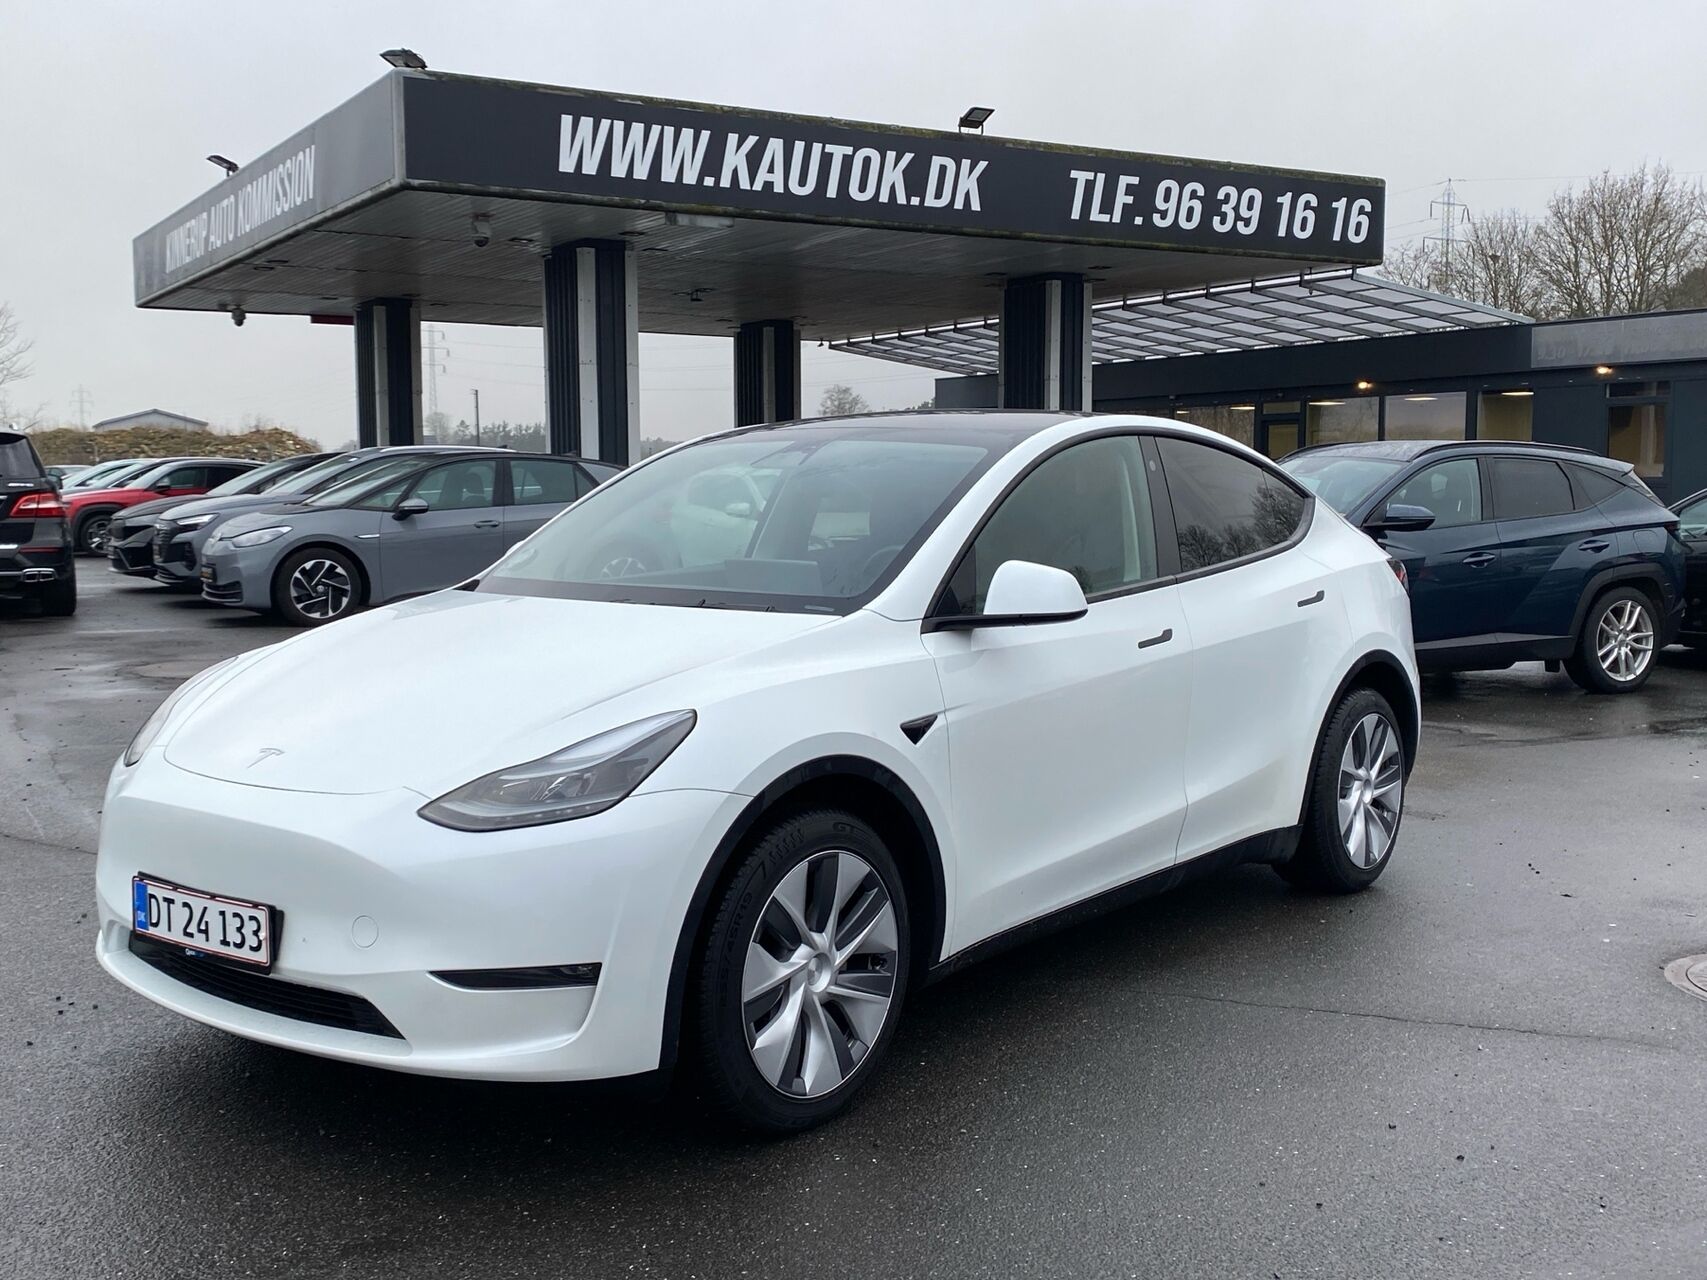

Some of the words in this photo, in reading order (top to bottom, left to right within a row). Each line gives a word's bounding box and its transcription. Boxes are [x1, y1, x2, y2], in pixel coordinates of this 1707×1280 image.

[208, 194, 235, 252] AUTO
[237, 144, 316, 237] KOMMISSION
[558, 113, 989, 212] WWW.KAUTOK.DK
[1069, 169, 1144, 225] TLF.
[1152, 178, 1205, 230] 96
[1212, 185, 1263, 236] 39
[1276, 191, 1318, 240] 16
[1331, 196, 1373, 244] 16
[148, 893, 175, 933] DT
[181, 901, 209, 943] 24
[219, 910, 263, 953] 133
